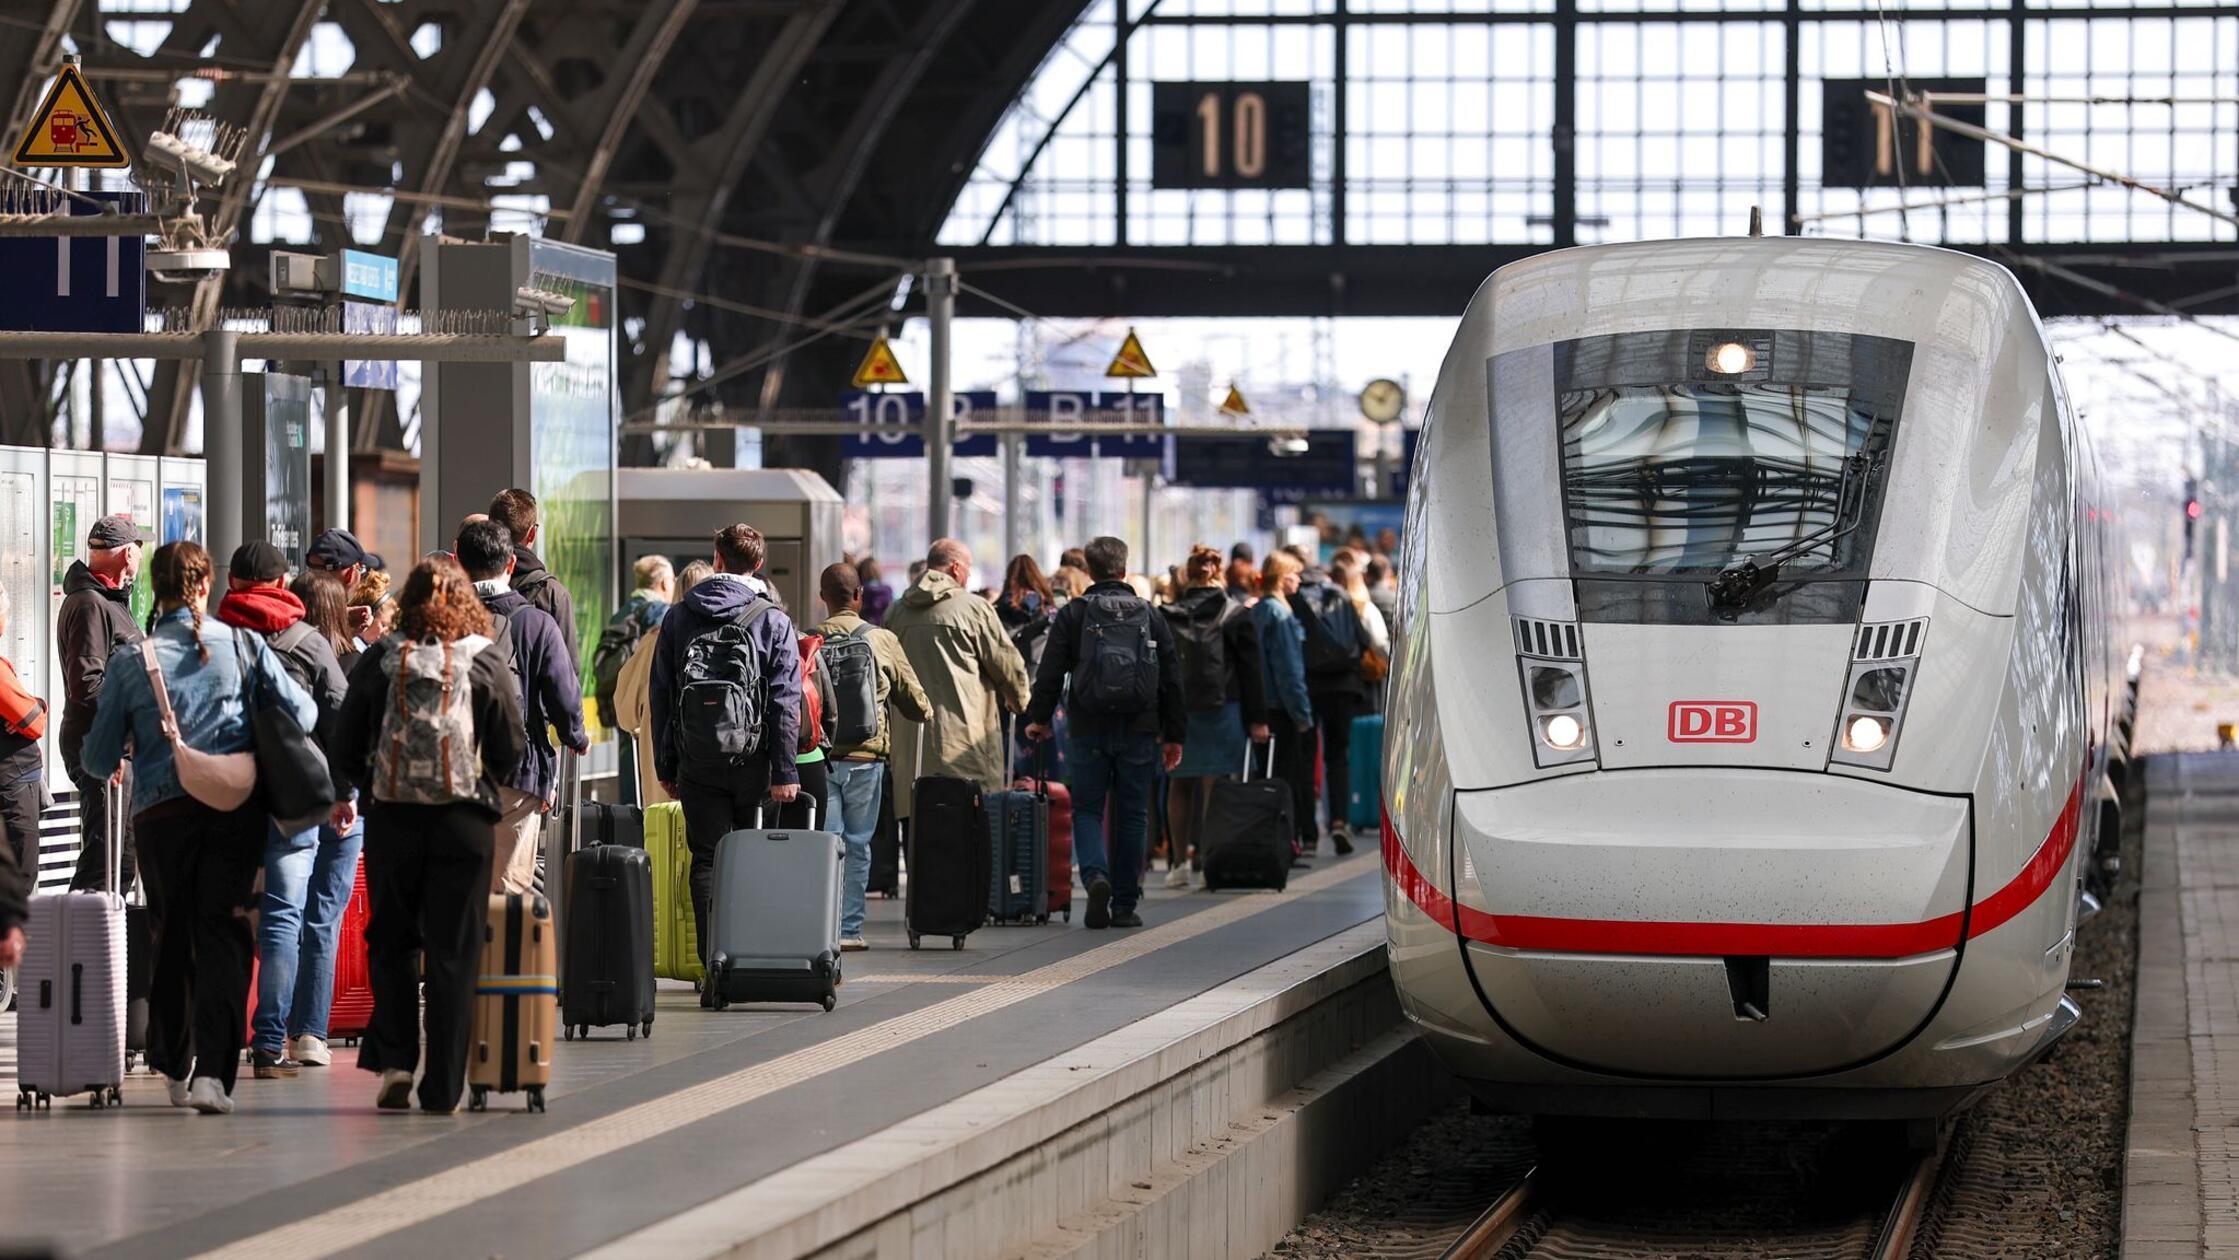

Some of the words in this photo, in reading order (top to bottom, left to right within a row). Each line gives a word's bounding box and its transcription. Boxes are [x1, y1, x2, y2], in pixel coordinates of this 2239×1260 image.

[1198, 91, 1265, 177] 10
[1870, 91, 1932, 175] 11
[848, 393, 908, 444] 10
[1050, 393, 1084, 443] B
[1113, 394, 1158, 443] 11
[1680, 707, 1746, 736] DB
